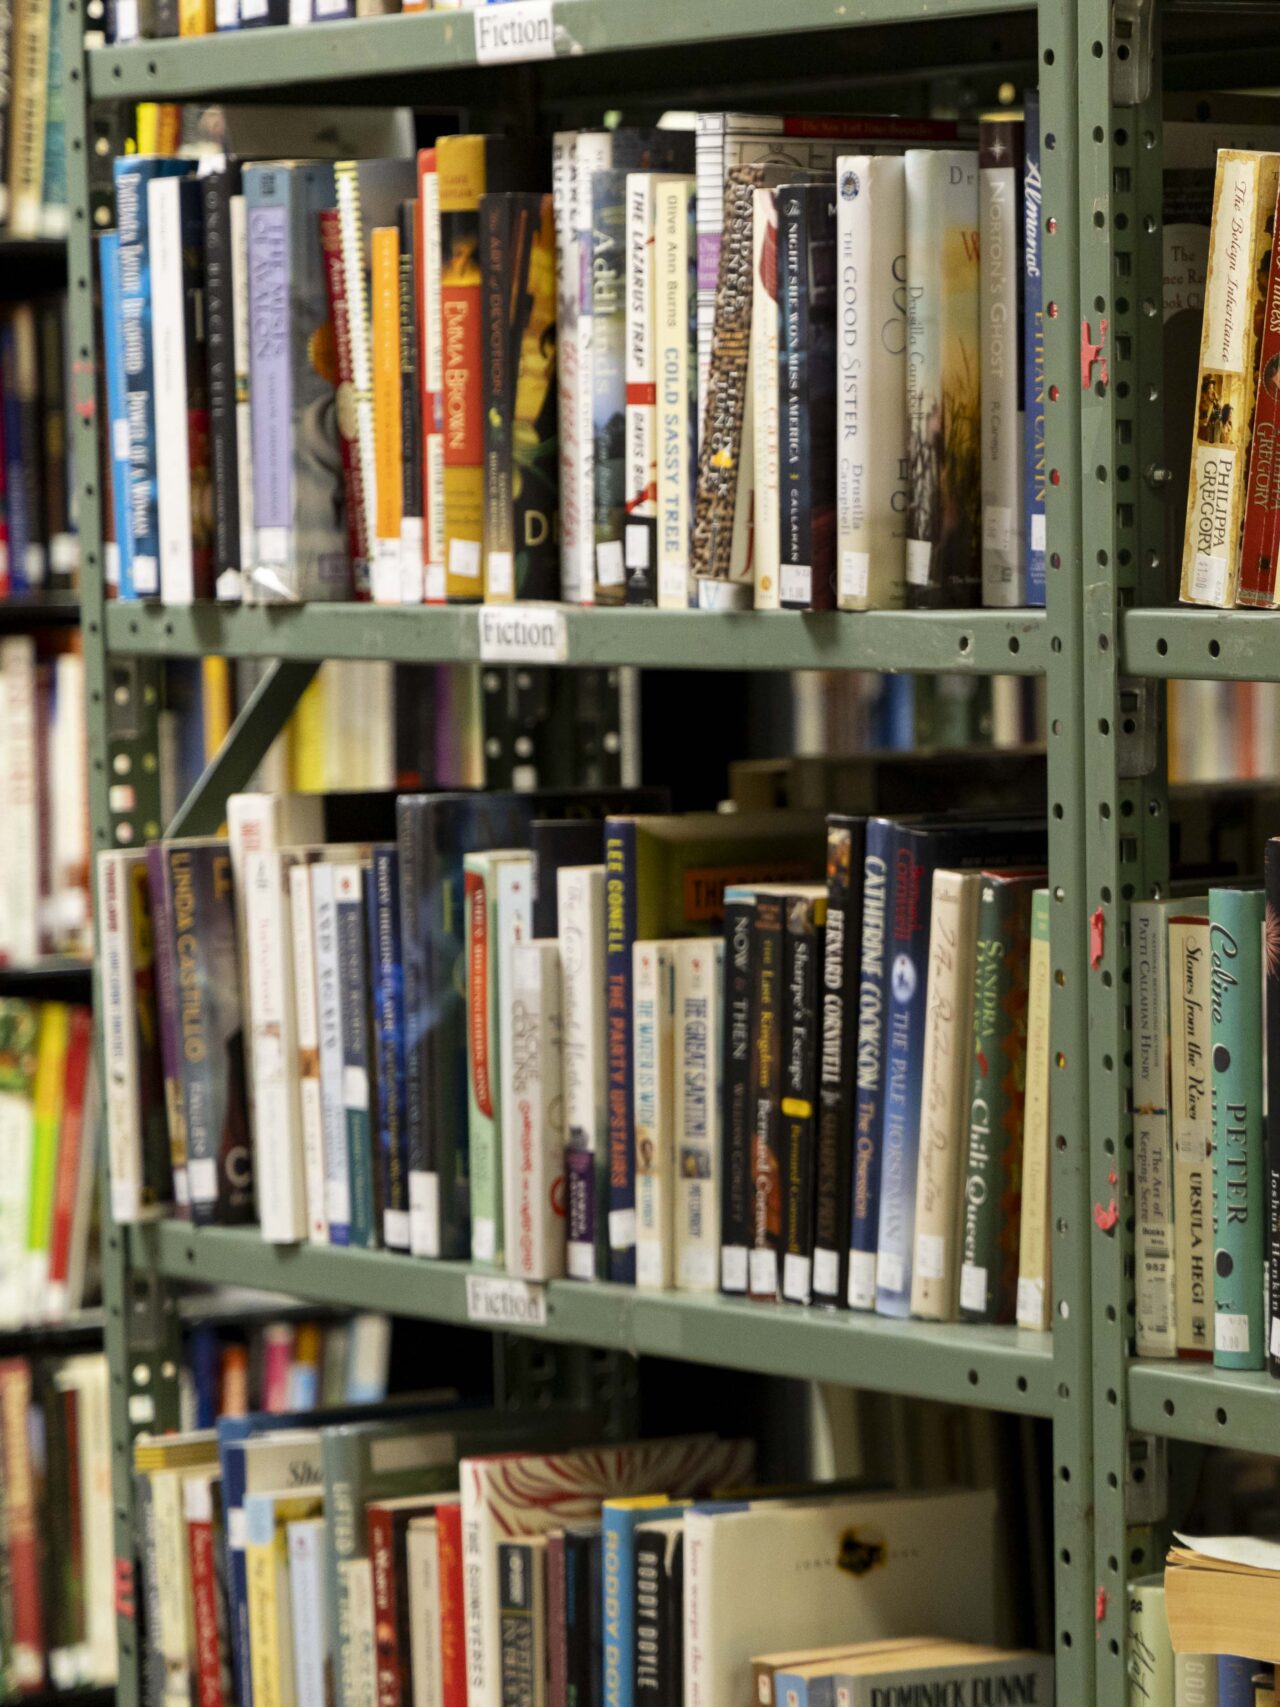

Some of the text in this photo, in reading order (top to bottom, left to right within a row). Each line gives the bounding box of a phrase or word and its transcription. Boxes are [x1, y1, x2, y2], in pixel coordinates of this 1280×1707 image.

[666, 194, 679, 328] Olive Ann Burns
[1022, 155, 1043, 278] Almanac
[631, 190, 646, 369] THE LAZARUS TRAP
[988, 180, 1008, 377] NORTON'S GHOST
[443, 300, 470, 450] EMMA BROWN
[787, 222, 800, 464] NIGHT SHE WON MISS AMERICA
[663, 347, 680, 558] COLD SASSY TREE
[1197, 460, 1218, 557] GREGORY
[1212, 459, 1233, 548] PHILIPPA
[789, 488, 800, 563] CALLAHAN
[171, 853, 207, 1063] LINDA CASTILLO
[732, 916, 750, 973] NOW
[823, 908, 845, 990] BERNARD
[856, 854, 888, 1092] CATHERINE COOKSON
[980, 940, 1004, 1038] SANDRA
[609, 975, 629, 1189] THE PARTY UPSTAIRS
[732, 999, 750, 1062] THEN
[821, 993, 844, 1085] CORNWELL
[854, 1101, 876, 1220] The Obsession
[1225, 1102, 1248, 1225] PETER
[637, 1550, 659, 1691] RODDY DOYLE
